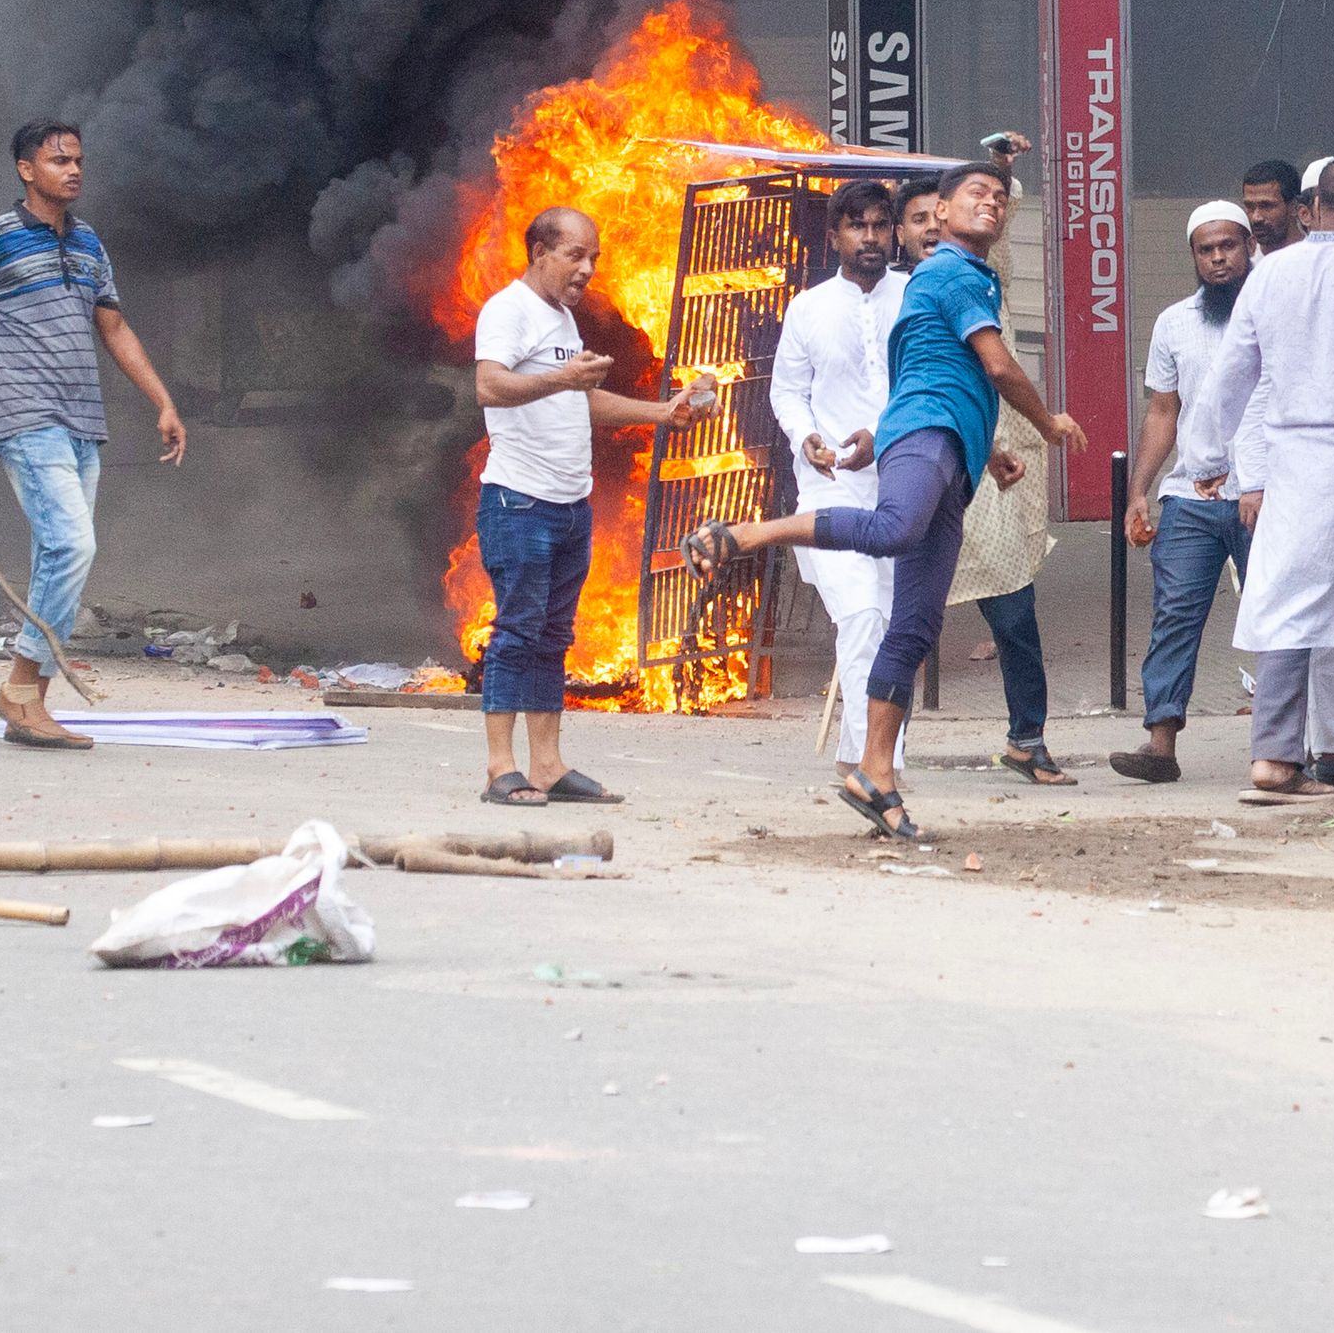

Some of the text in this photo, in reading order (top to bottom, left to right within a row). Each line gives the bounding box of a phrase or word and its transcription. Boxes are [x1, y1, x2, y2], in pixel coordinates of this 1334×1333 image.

[1067, 131, 1085, 240] DIGITAL
[1087, 37, 1118, 332] TRANSCOM
[555, 347, 578, 362] DI
